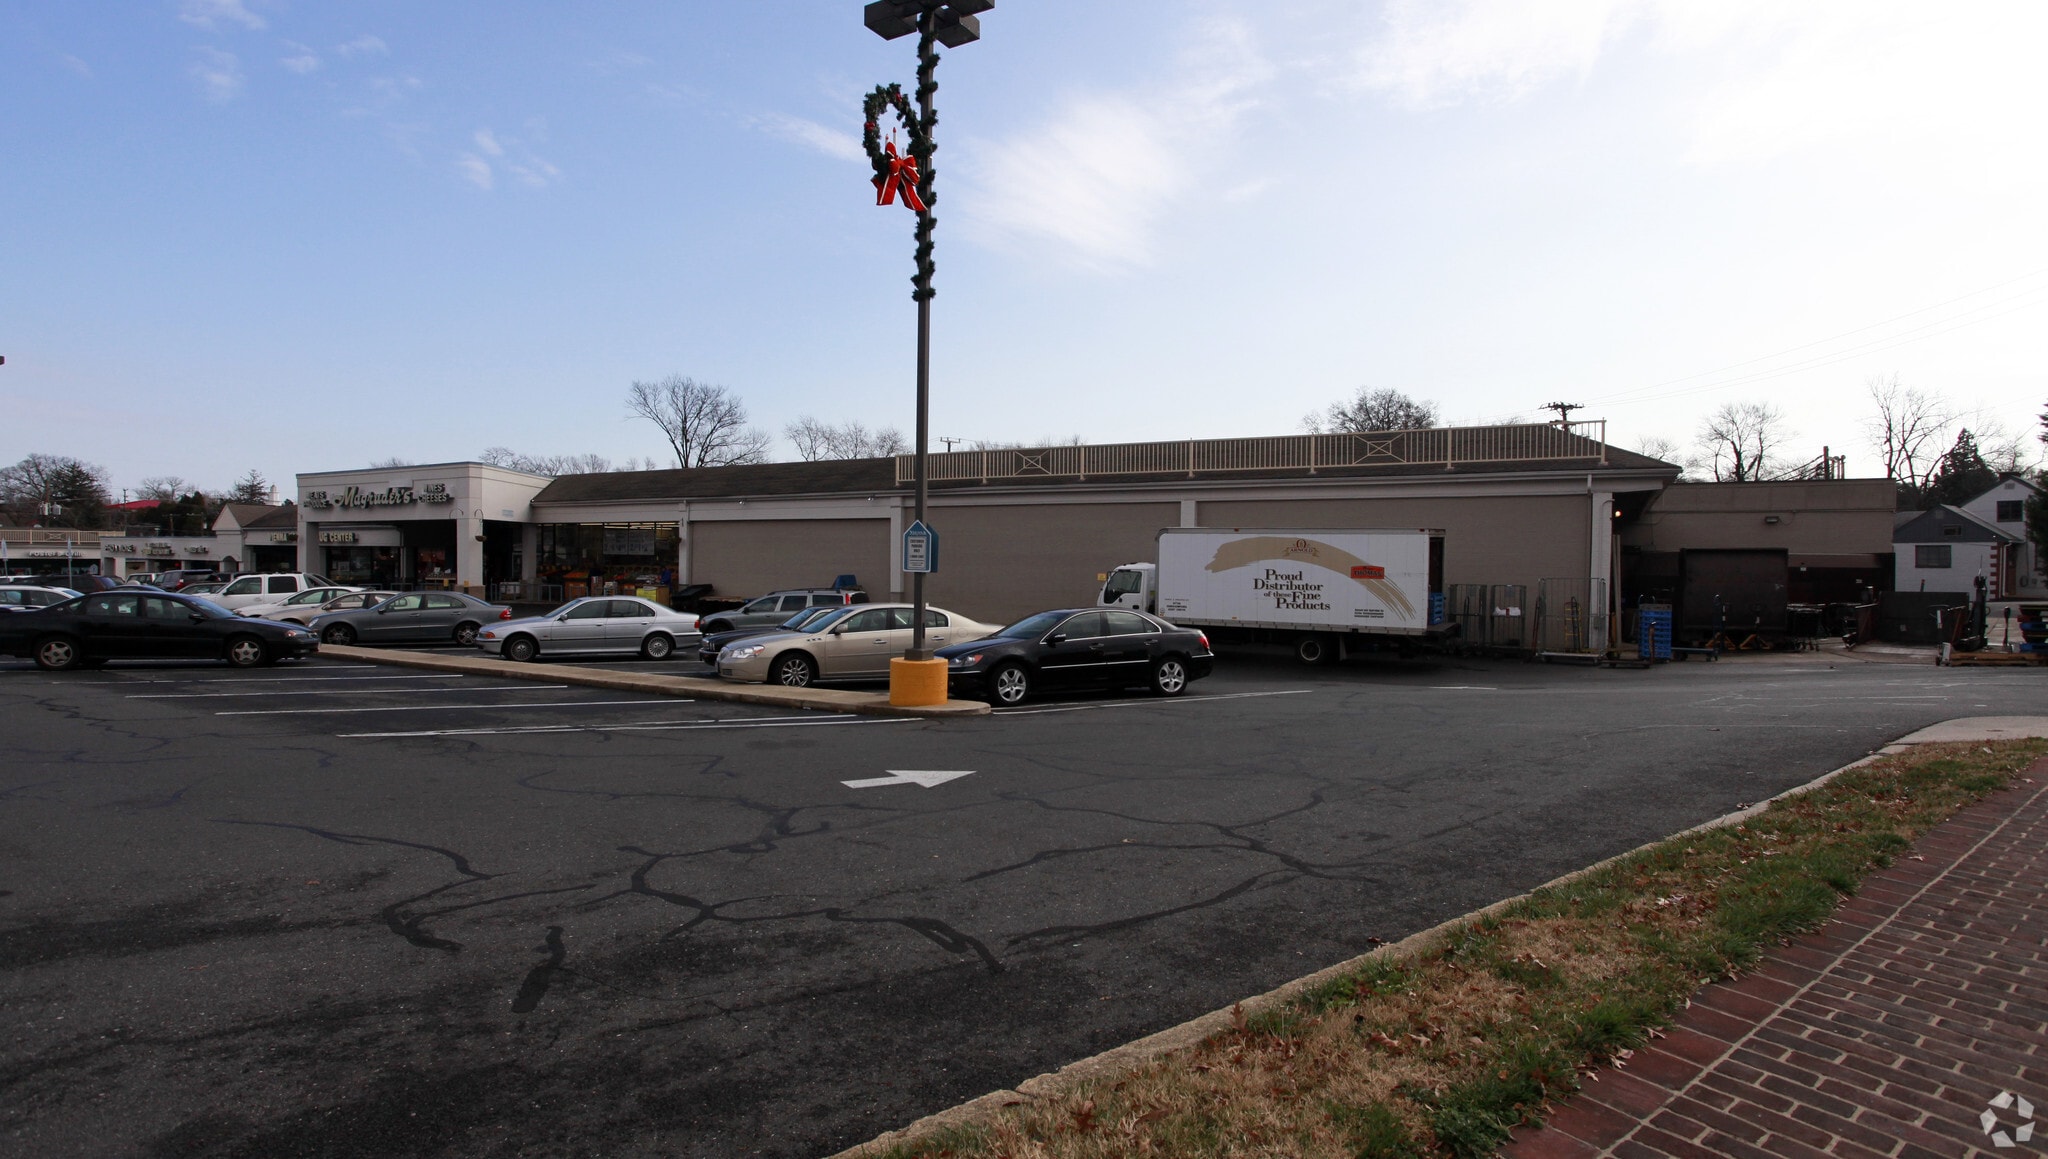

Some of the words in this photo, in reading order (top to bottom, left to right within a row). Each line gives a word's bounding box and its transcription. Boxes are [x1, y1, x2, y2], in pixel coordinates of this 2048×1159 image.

[332, 485, 411, 508] Magruder's
[418, 493, 447, 504] CHEESES
[330, 531, 353, 542] CENTER
[1265, 568, 1303, 581] Proud
[1253, 578, 1323, 591] Distributor
[1273, 590, 1292, 598] these
[1292, 590, 1321, 602] Fine
[1275, 597, 1331, 610] Products
